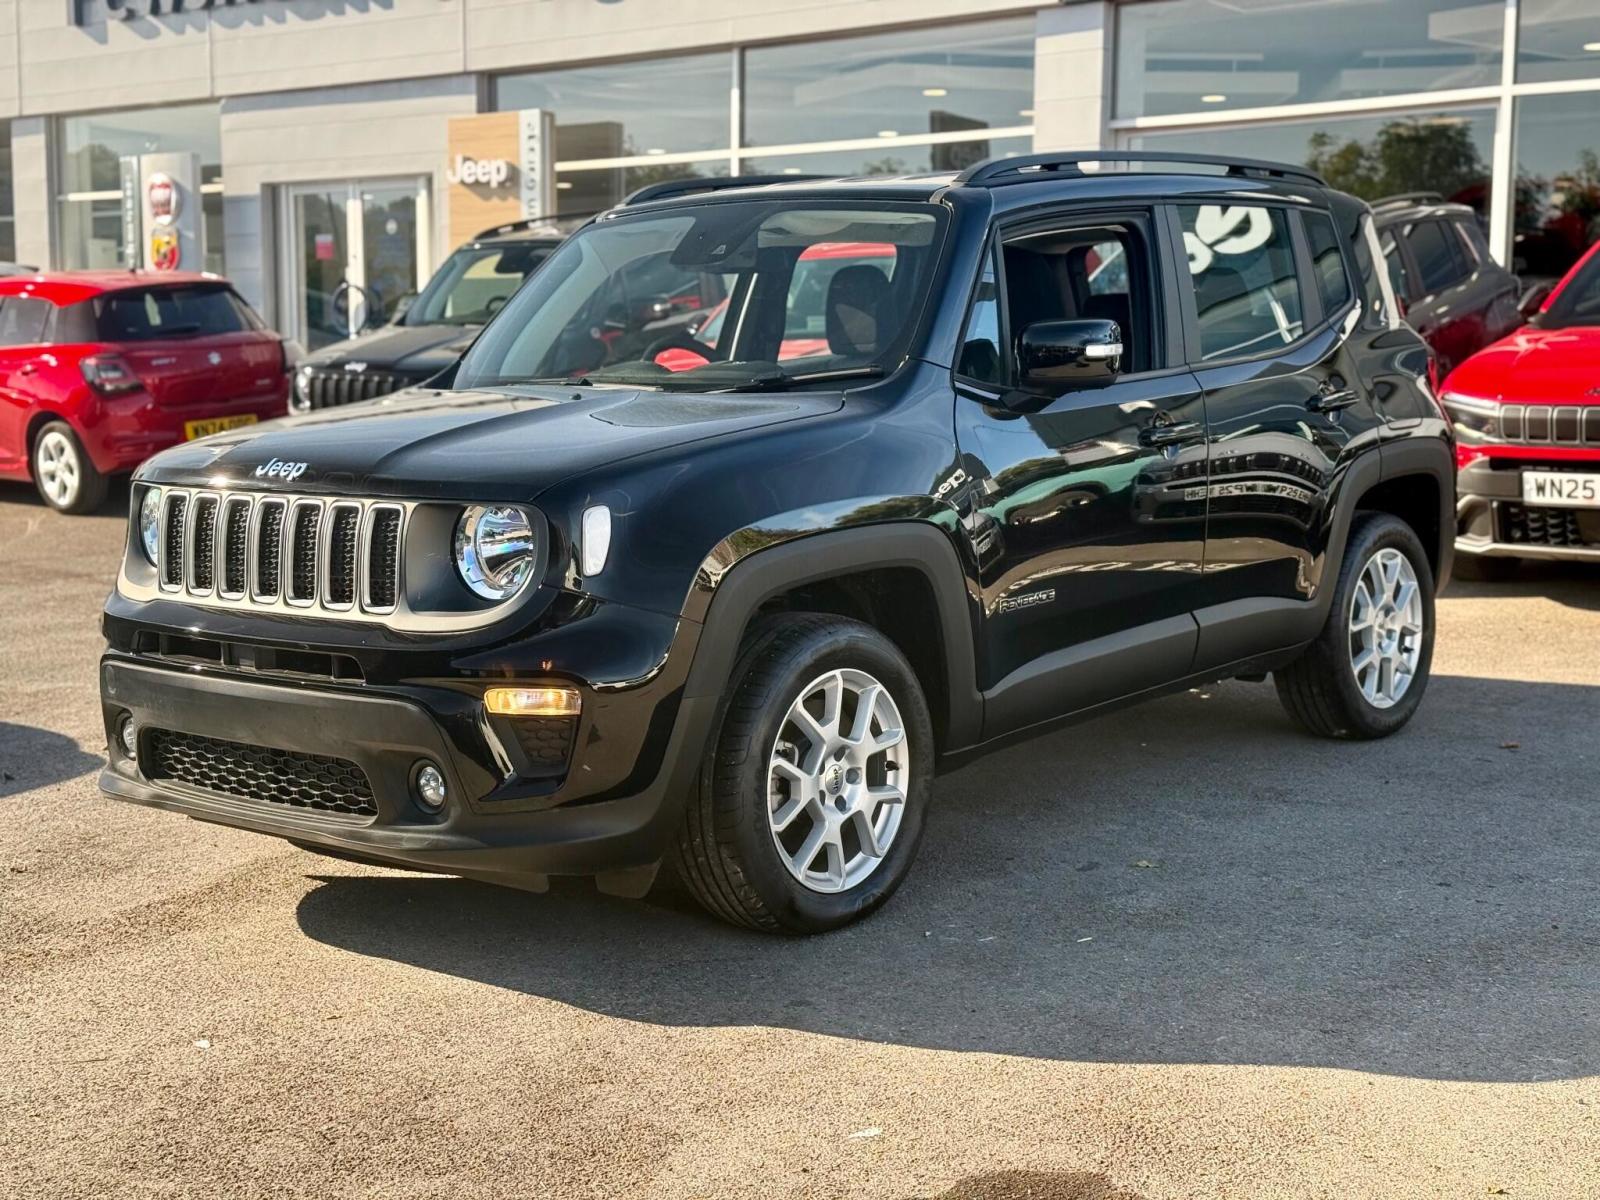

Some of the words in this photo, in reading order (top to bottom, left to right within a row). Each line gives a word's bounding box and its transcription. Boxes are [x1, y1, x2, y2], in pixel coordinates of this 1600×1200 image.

[446, 154, 507, 188] Jeep
[255, 457, 307, 481] Jeep
[1534, 478, 1595, 499] WN25
